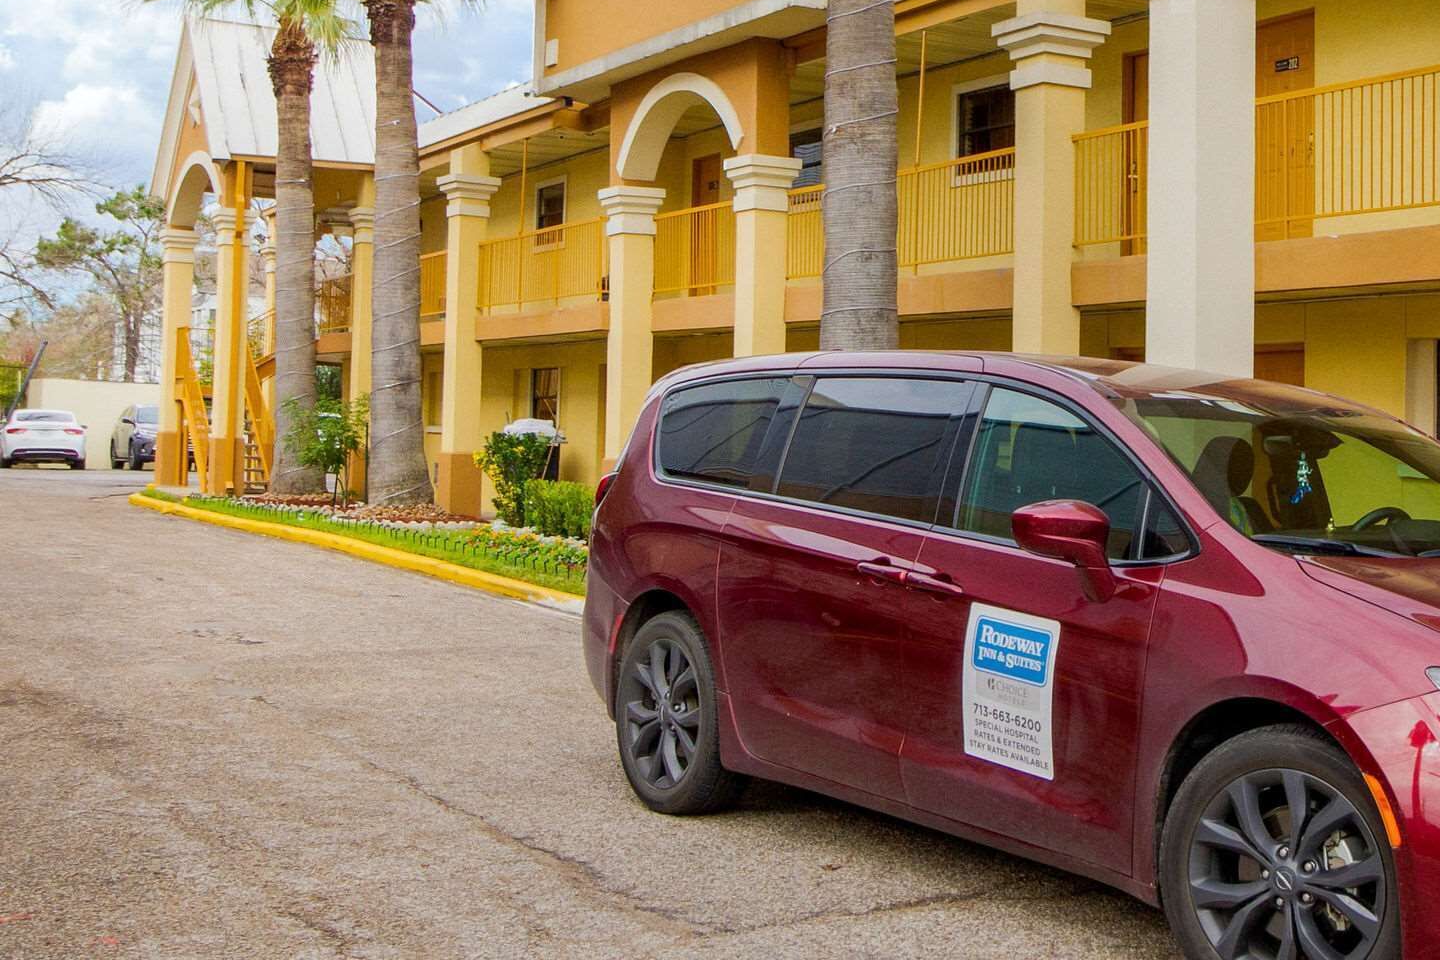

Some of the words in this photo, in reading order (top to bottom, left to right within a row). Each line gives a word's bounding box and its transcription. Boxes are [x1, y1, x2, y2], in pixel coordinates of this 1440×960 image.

[980, 624, 1044, 657] RODEWAY
[978, 646, 998, 660] INN
[997, 651, 1005, 662] &
[1005, 653, 1042, 672] SUITES
[996, 680, 1028, 698] CHOICE
[973, 702, 1041, 732] 713-663-6200
[974, 729, 995, 742] RATES
[996, 736, 1002, 744] &
[1003, 738, 1041, 756] EXTENDED
[975, 718, 1003, 733] SPECIAL
[1004, 727, 1039, 744] HOSPITAL
[969, 739, 985, 750] STAY
[987, 745, 1008, 758] RATES
[1010, 752, 1049, 770] AVAILABLE
